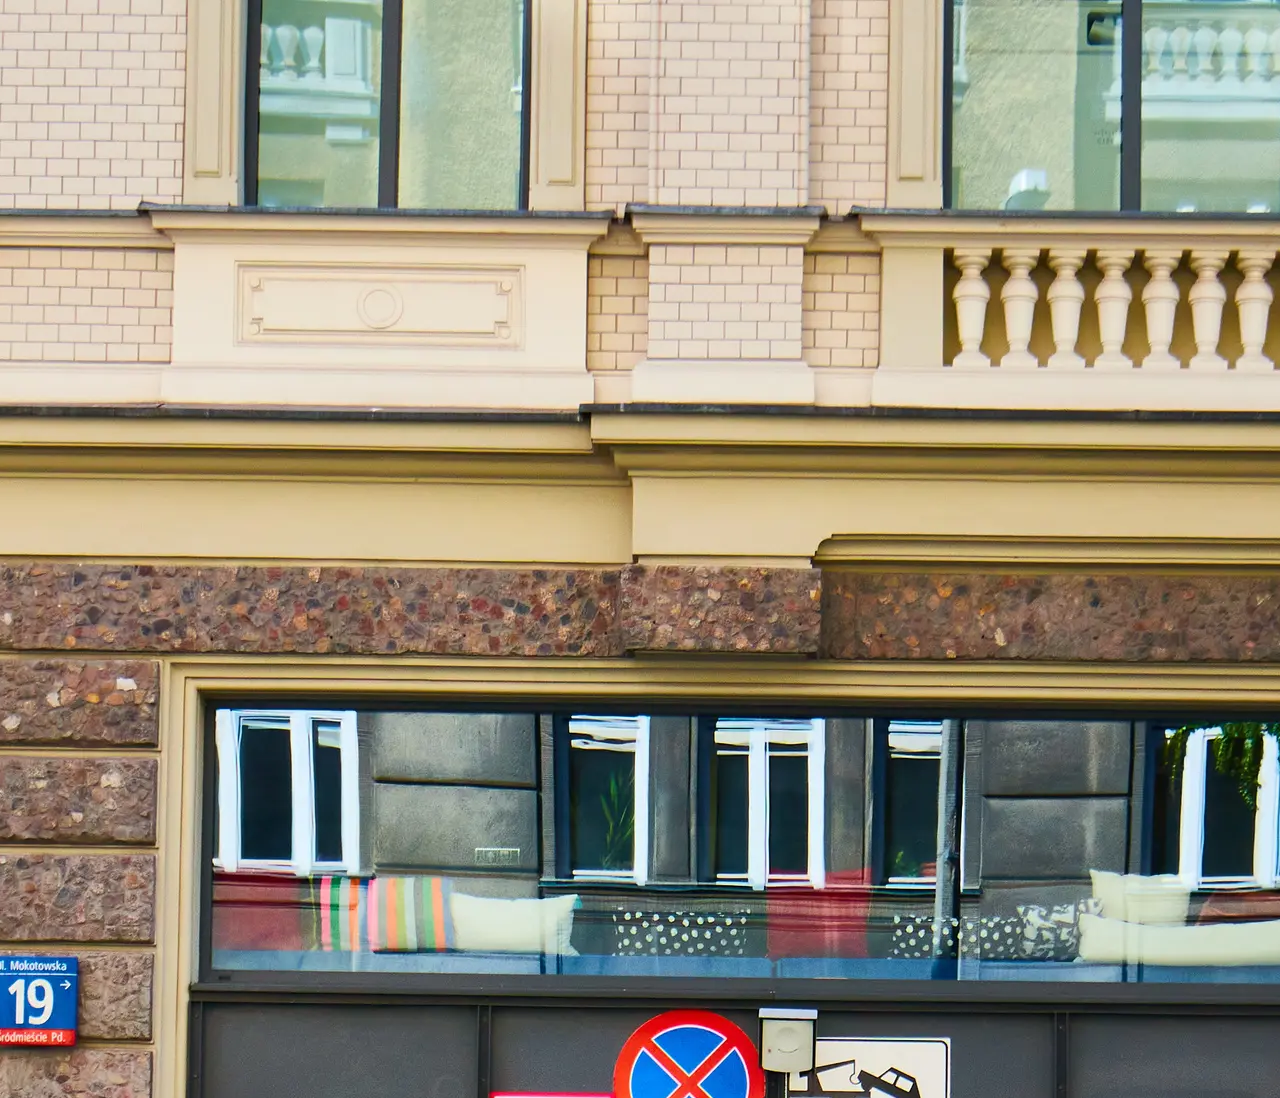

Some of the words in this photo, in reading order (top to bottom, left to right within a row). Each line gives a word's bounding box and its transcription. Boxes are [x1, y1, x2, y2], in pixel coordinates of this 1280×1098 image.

[10, 960, 68, 971] Mokotowska
[8, 978, 54, 1025] 19
[51, 1032, 66, 1043] Pd.
